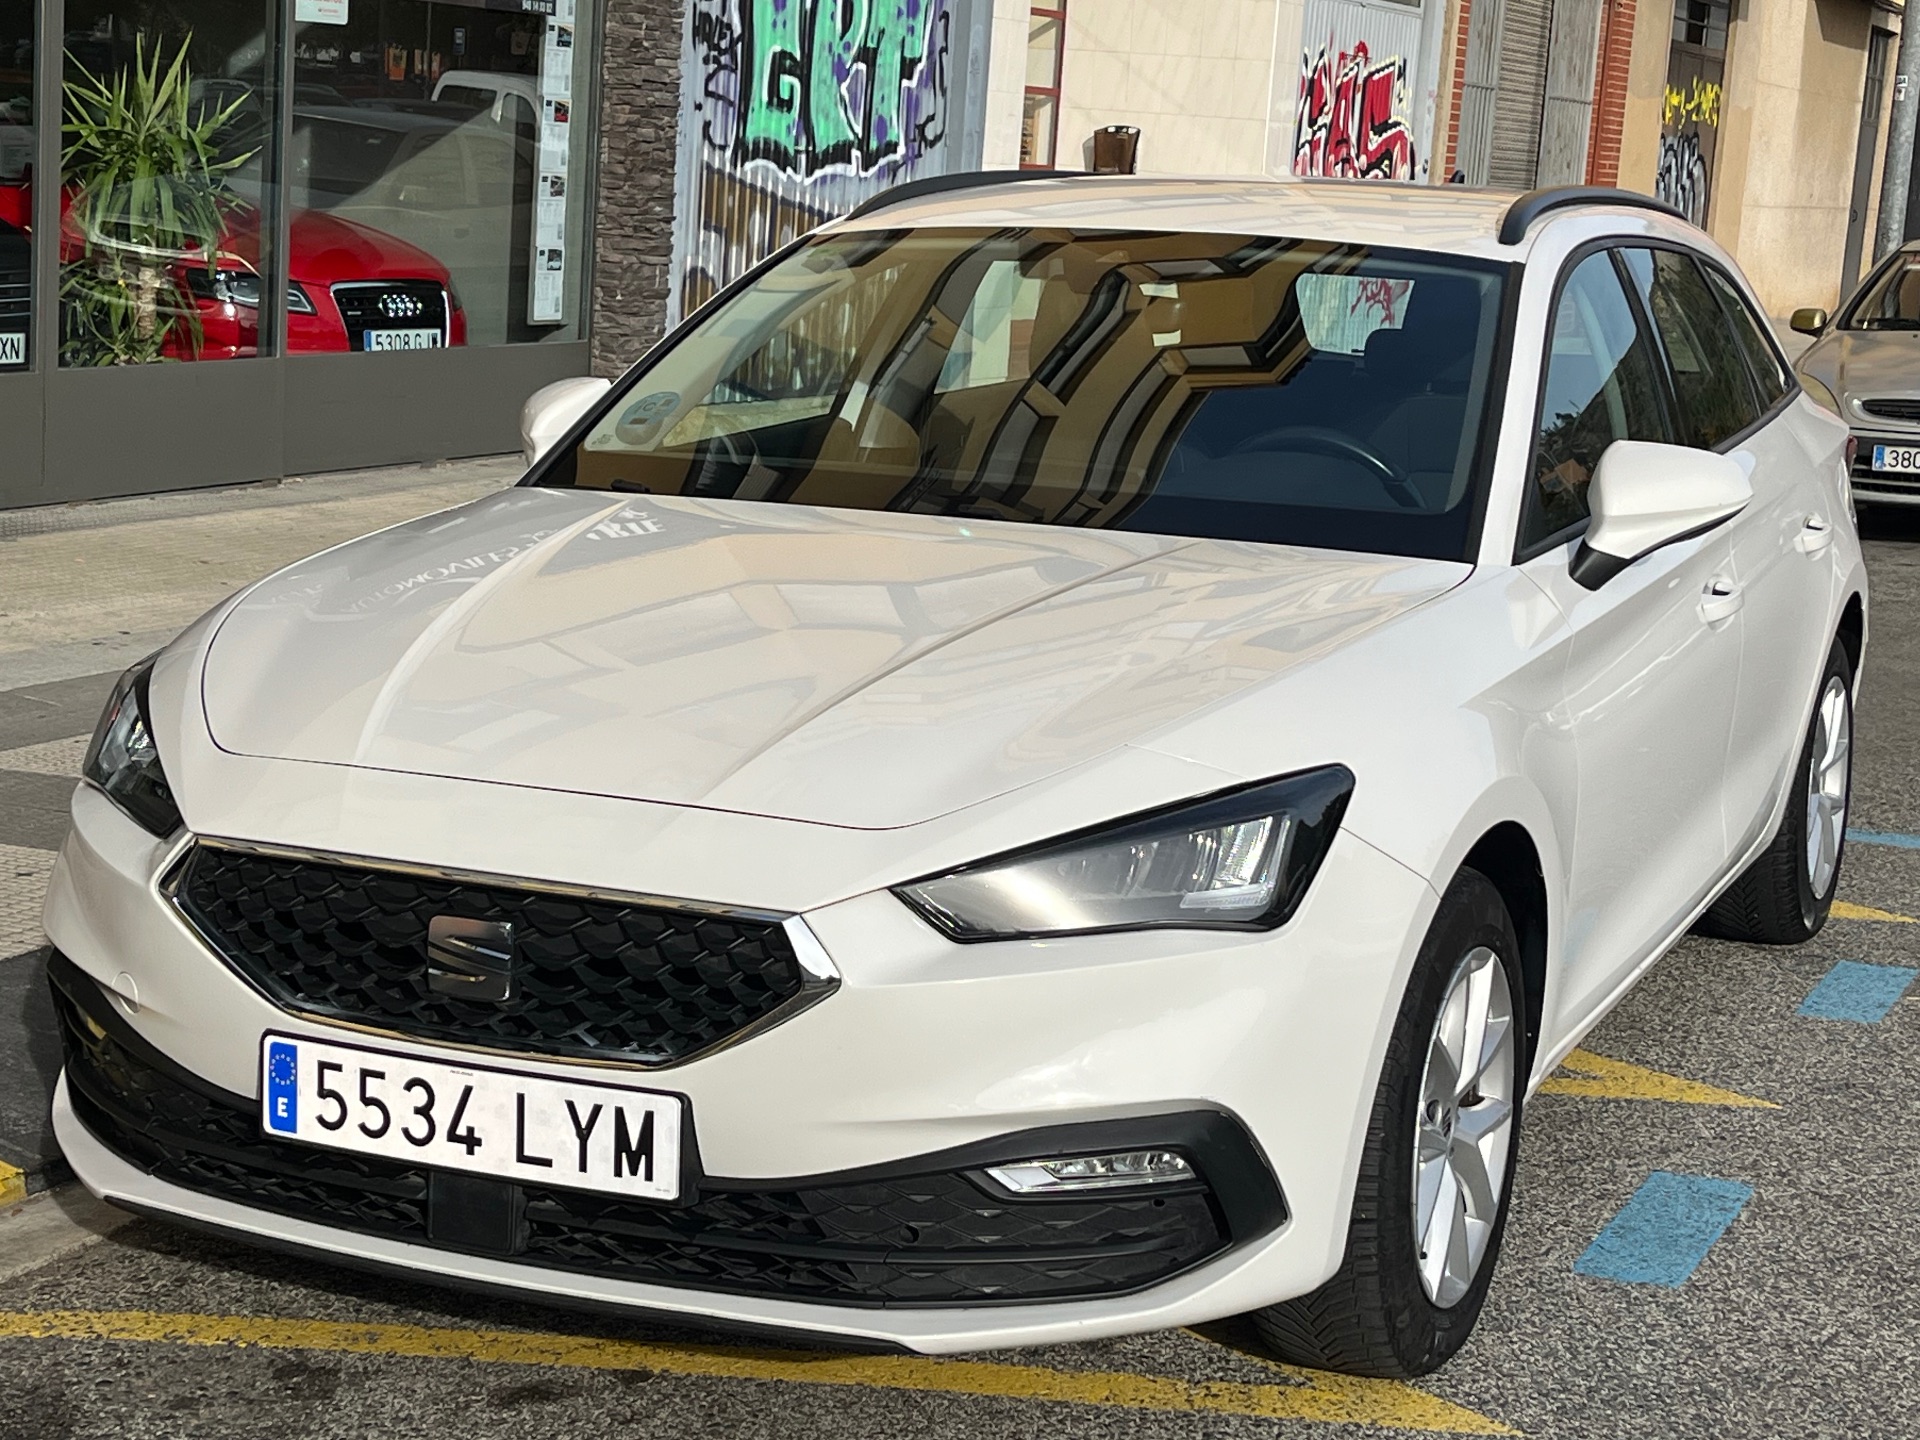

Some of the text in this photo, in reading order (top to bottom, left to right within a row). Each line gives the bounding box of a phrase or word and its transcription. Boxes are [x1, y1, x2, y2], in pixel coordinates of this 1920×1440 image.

[375, 333, 411, 350] 5308
[277, 1097, 288, 1118] E
[315, 1059, 655, 1182] 5534 LYM
